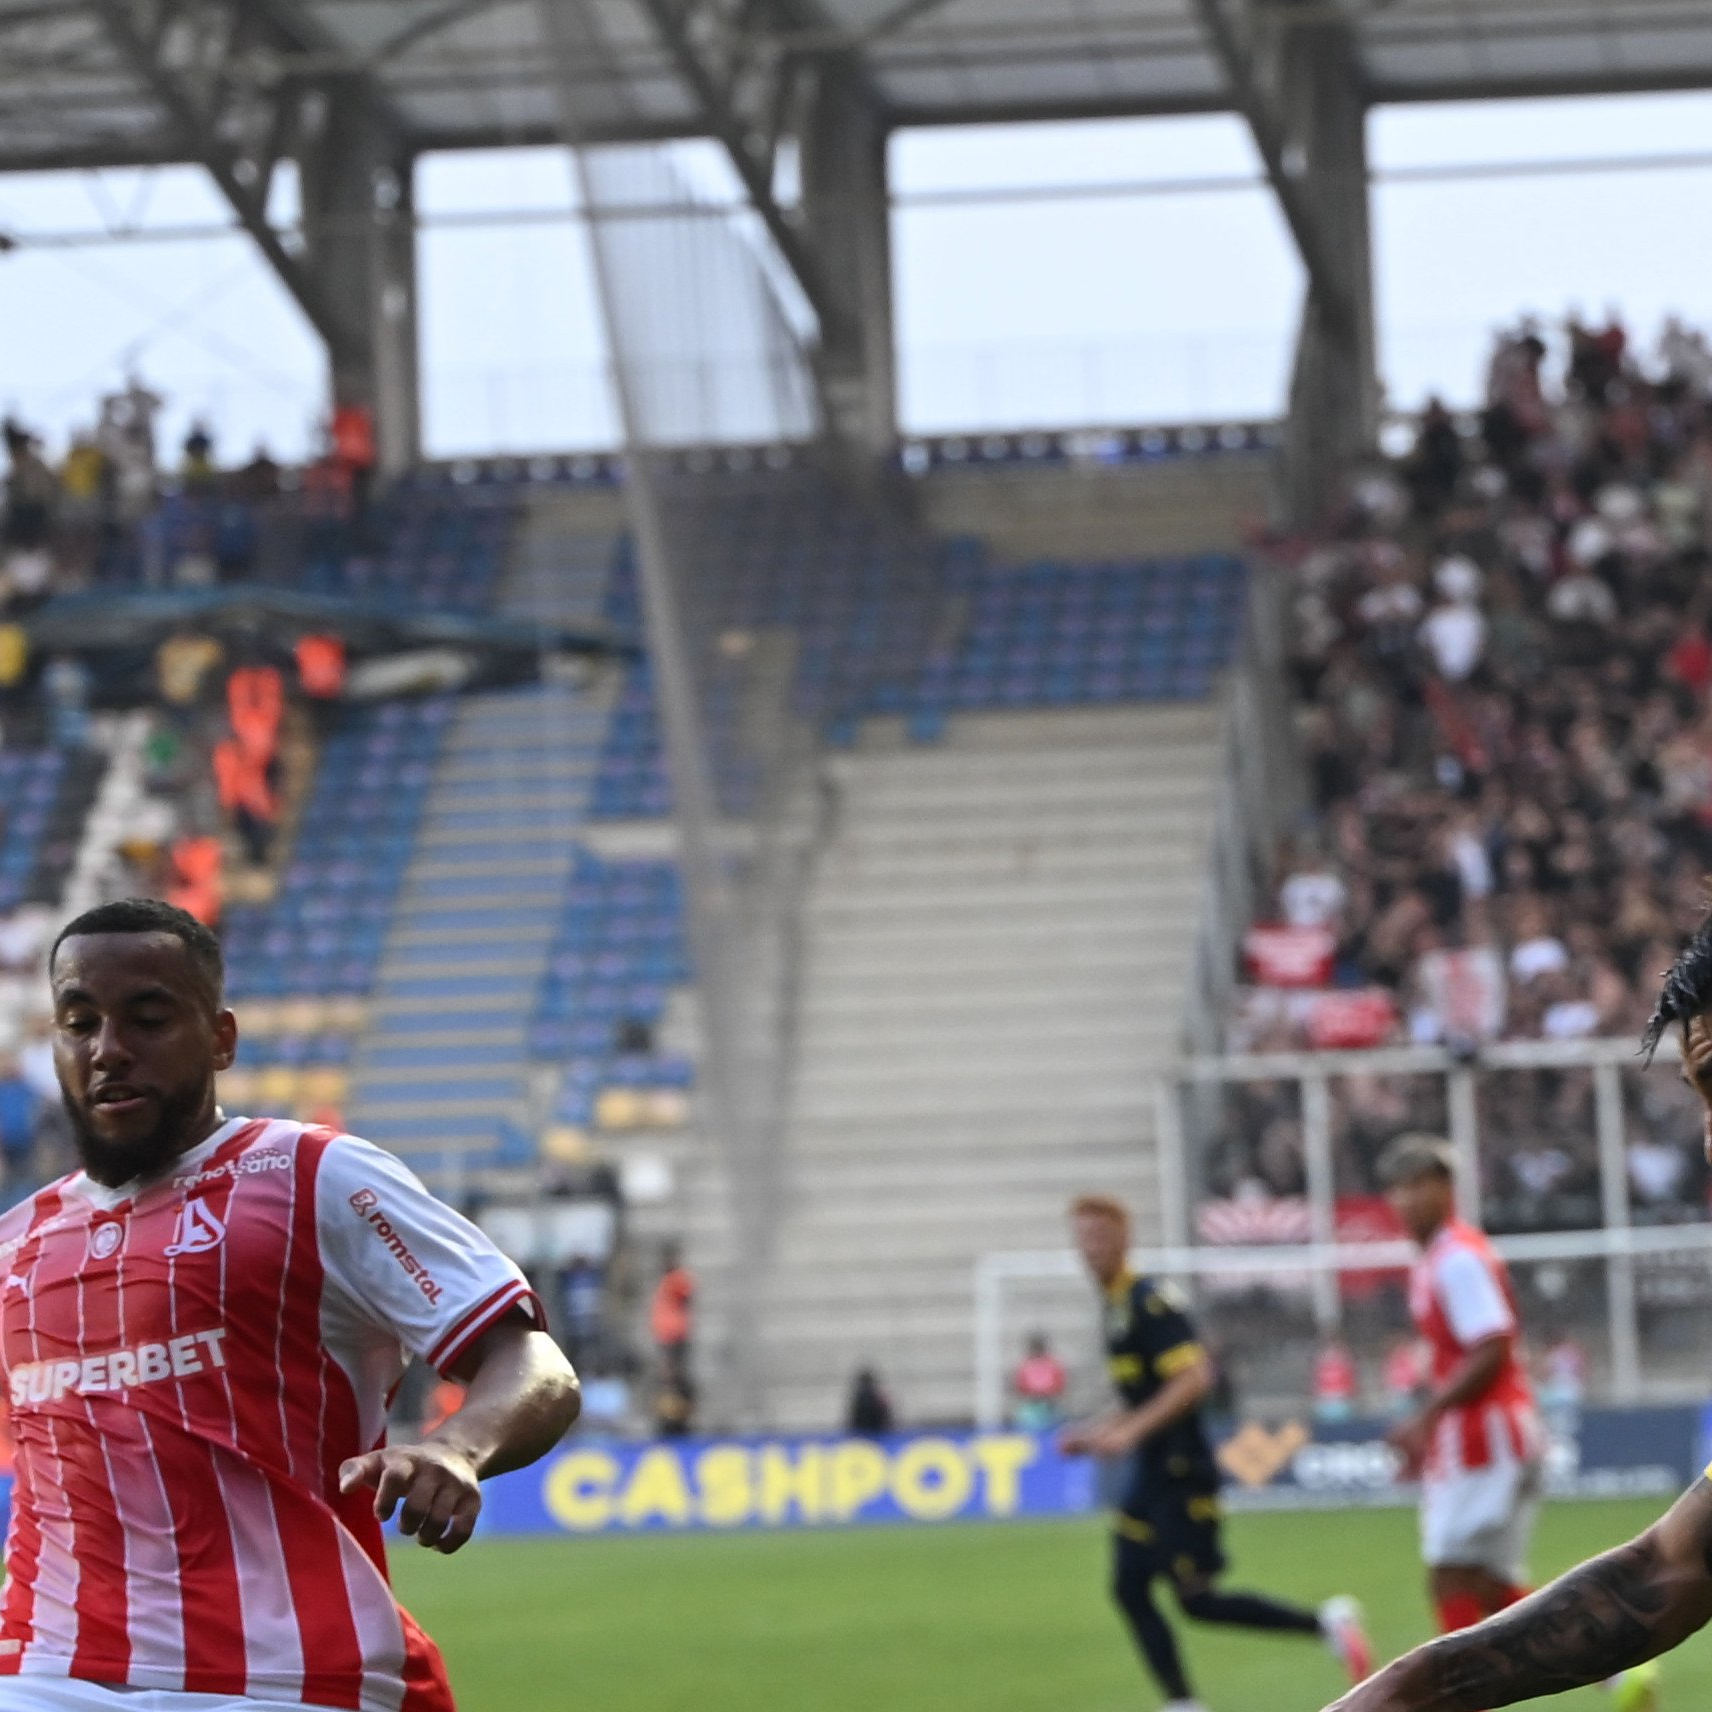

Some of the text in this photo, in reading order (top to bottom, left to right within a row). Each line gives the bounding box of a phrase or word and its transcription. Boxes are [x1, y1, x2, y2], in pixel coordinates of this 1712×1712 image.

[368, 1211, 443, 1306] romstal
[10, 1327, 226, 1407] SUPERBET
[542, 1437, 1037, 1531] CASHPOT
